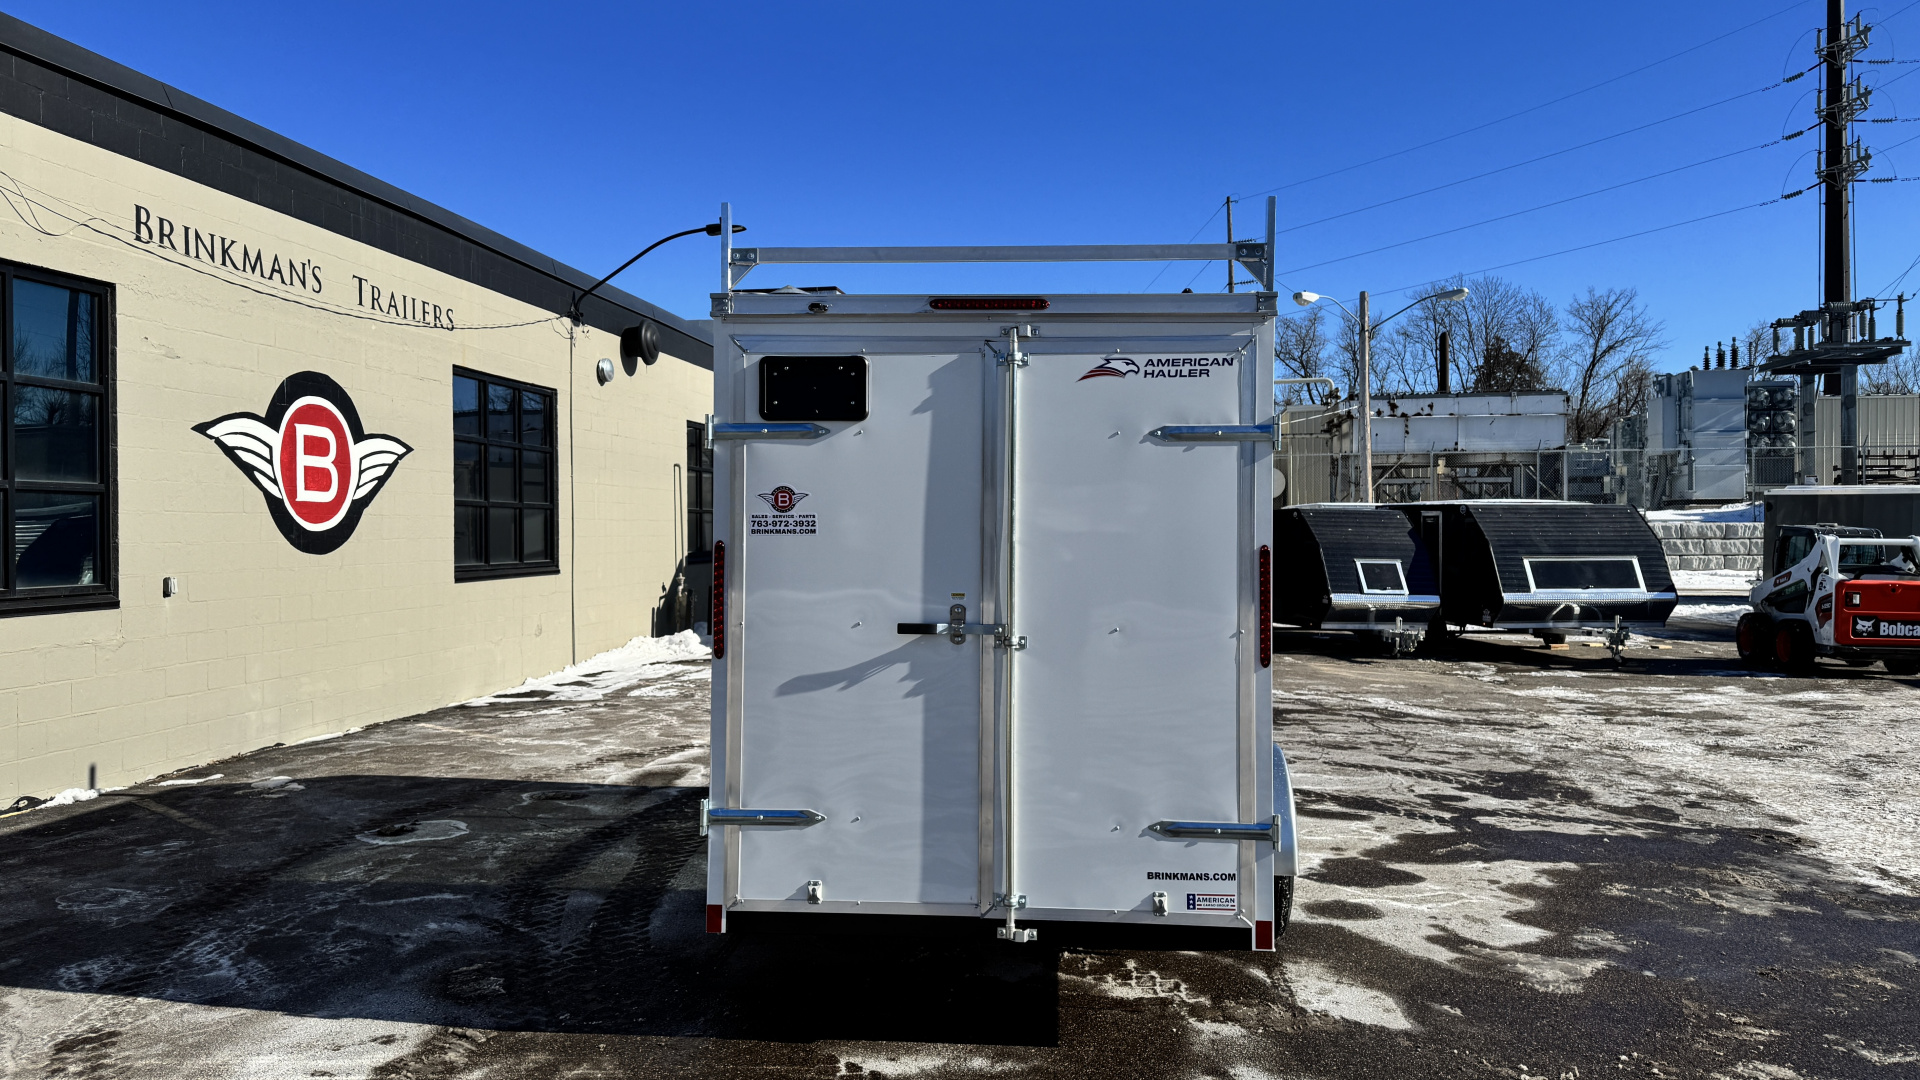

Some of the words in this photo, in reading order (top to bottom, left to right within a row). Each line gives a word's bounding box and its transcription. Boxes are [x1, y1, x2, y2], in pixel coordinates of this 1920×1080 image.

[134, 204, 322, 293] BRINKMAN'S
[352, 275, 454, 331] TRAILERS
[1144, 358, 1234, 367] AMERICAN
[1144, 369, 1210, 378] HAULER
[294, 423, 338, 502] B
[778, 493, 790, 506] B
[1147, 872, 1236, 881] BRINKMANS.COM
